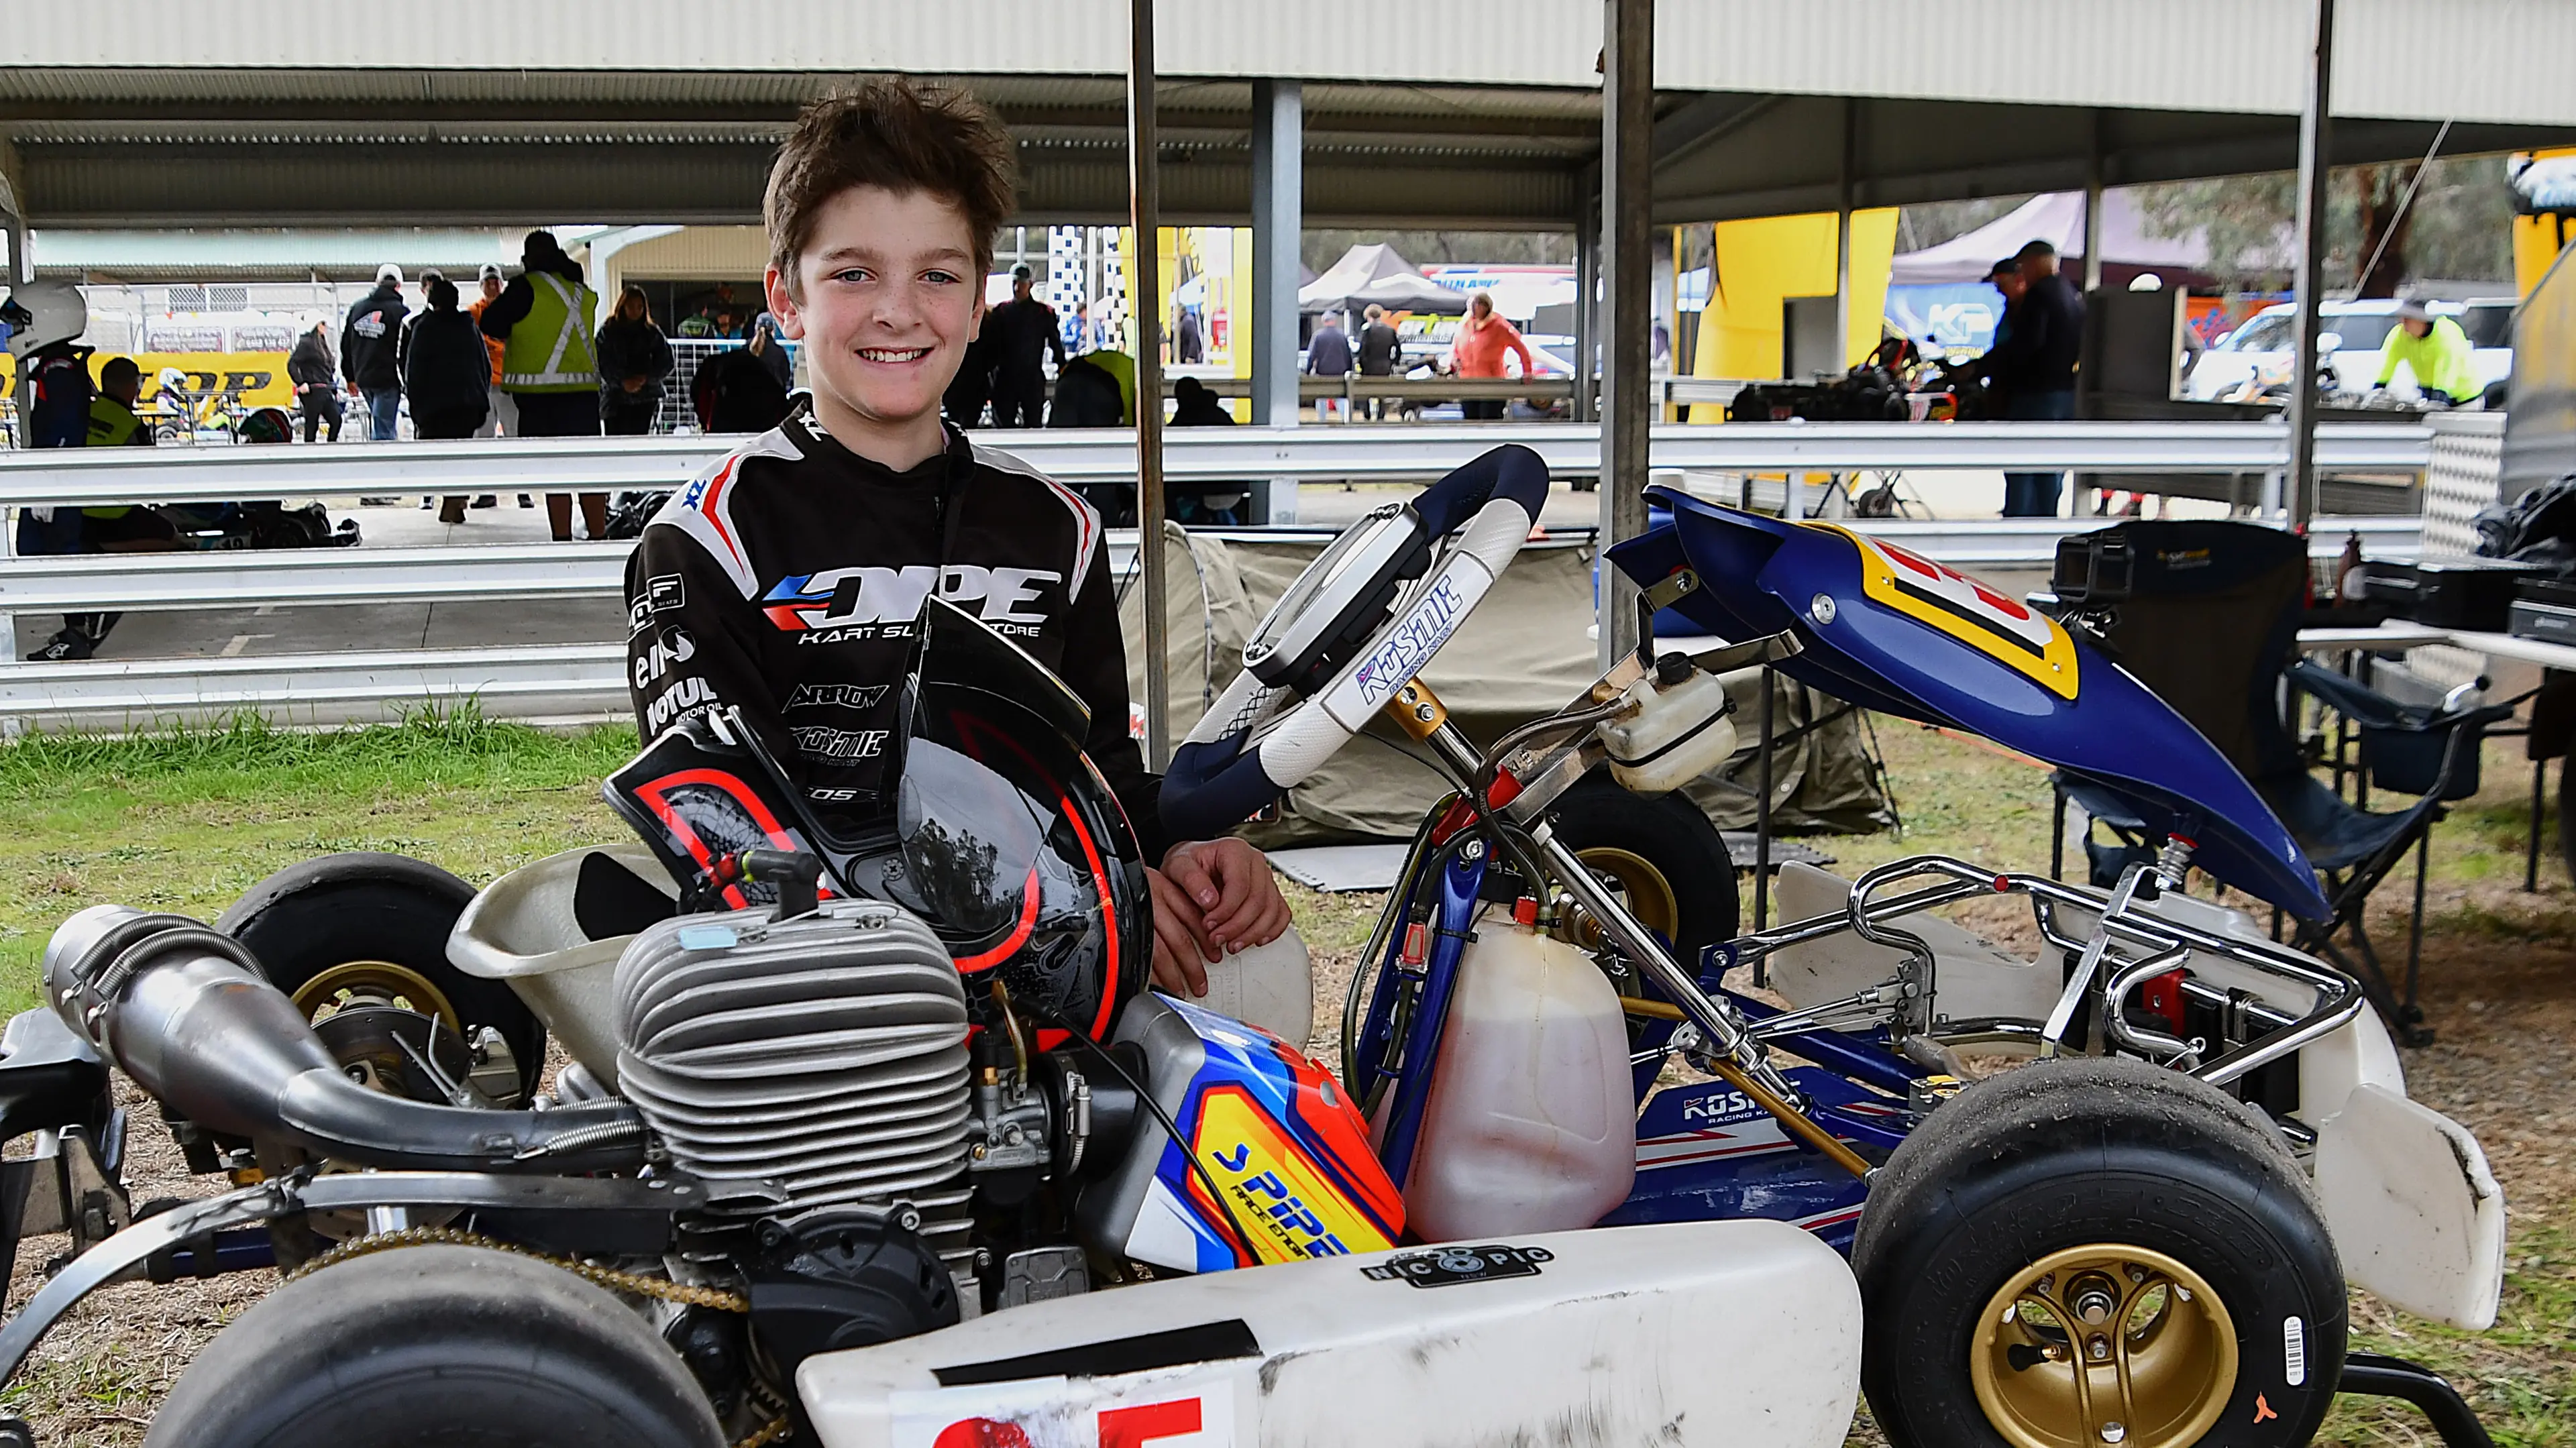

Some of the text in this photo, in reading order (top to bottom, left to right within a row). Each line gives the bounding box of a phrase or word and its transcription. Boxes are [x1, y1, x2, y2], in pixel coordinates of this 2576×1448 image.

[798, 626, 875, 645] KART
[1356, 575, 1463, 705] KOSMIC
[1389, 621, 1453, 695] RACING KART
[706, 703, 724, 713] OIL
[781, 683, 890, 714] ARROW
[1709, 1112, 1752, 1124] RACING
[1230, 1185, 1271, 1223] RACE
[1367, 1247, 1550, 1280] NIC PIC
